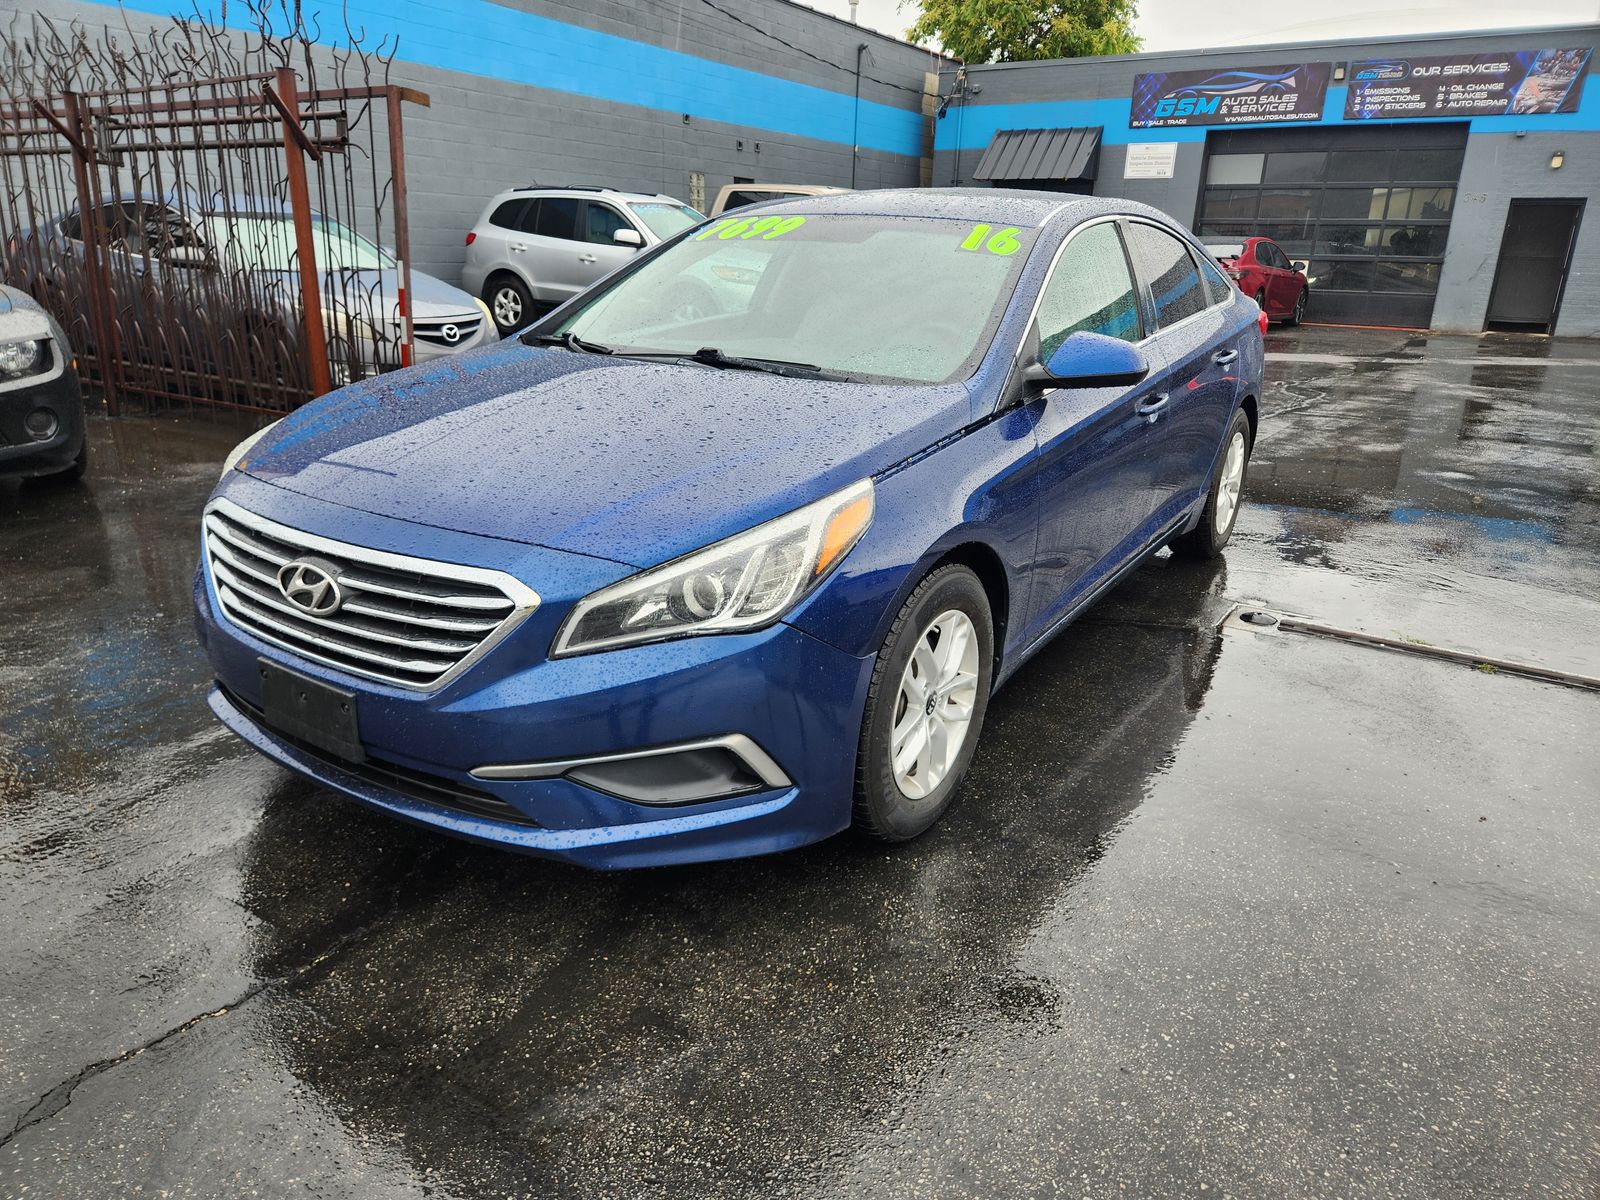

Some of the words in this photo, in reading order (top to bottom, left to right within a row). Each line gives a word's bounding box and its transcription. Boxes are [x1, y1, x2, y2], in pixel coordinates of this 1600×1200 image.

[1412, 66, 1441, 76] OUR
[1443, 62, 1511, 75] SERVICES:
[1364, 86, 1411, 95] EMISSIONS
[1466, 82, 1505, 91] CHANGE
[1222, 96, 1257, 106] AUTO
[1258, 93, 1299, 104] SALES
[1365, 94, 1421, 103] INSPECTIONS
[1449, 91, 1488, 100] BRAKES
[1153, 96, 1222, 117] GSM
[1219, 105, 1229, 114] &
[1231, 102, 1296, 114] SERVICES
[1364, 103, 1384, 111] DMV
[1384, 101, 1427, 110] STICKERS
[1447, 100, 1473, 108] AUTO
[1473, 98, 1508, 107] REPAIR
[960, 223, 1022, 256] 16
